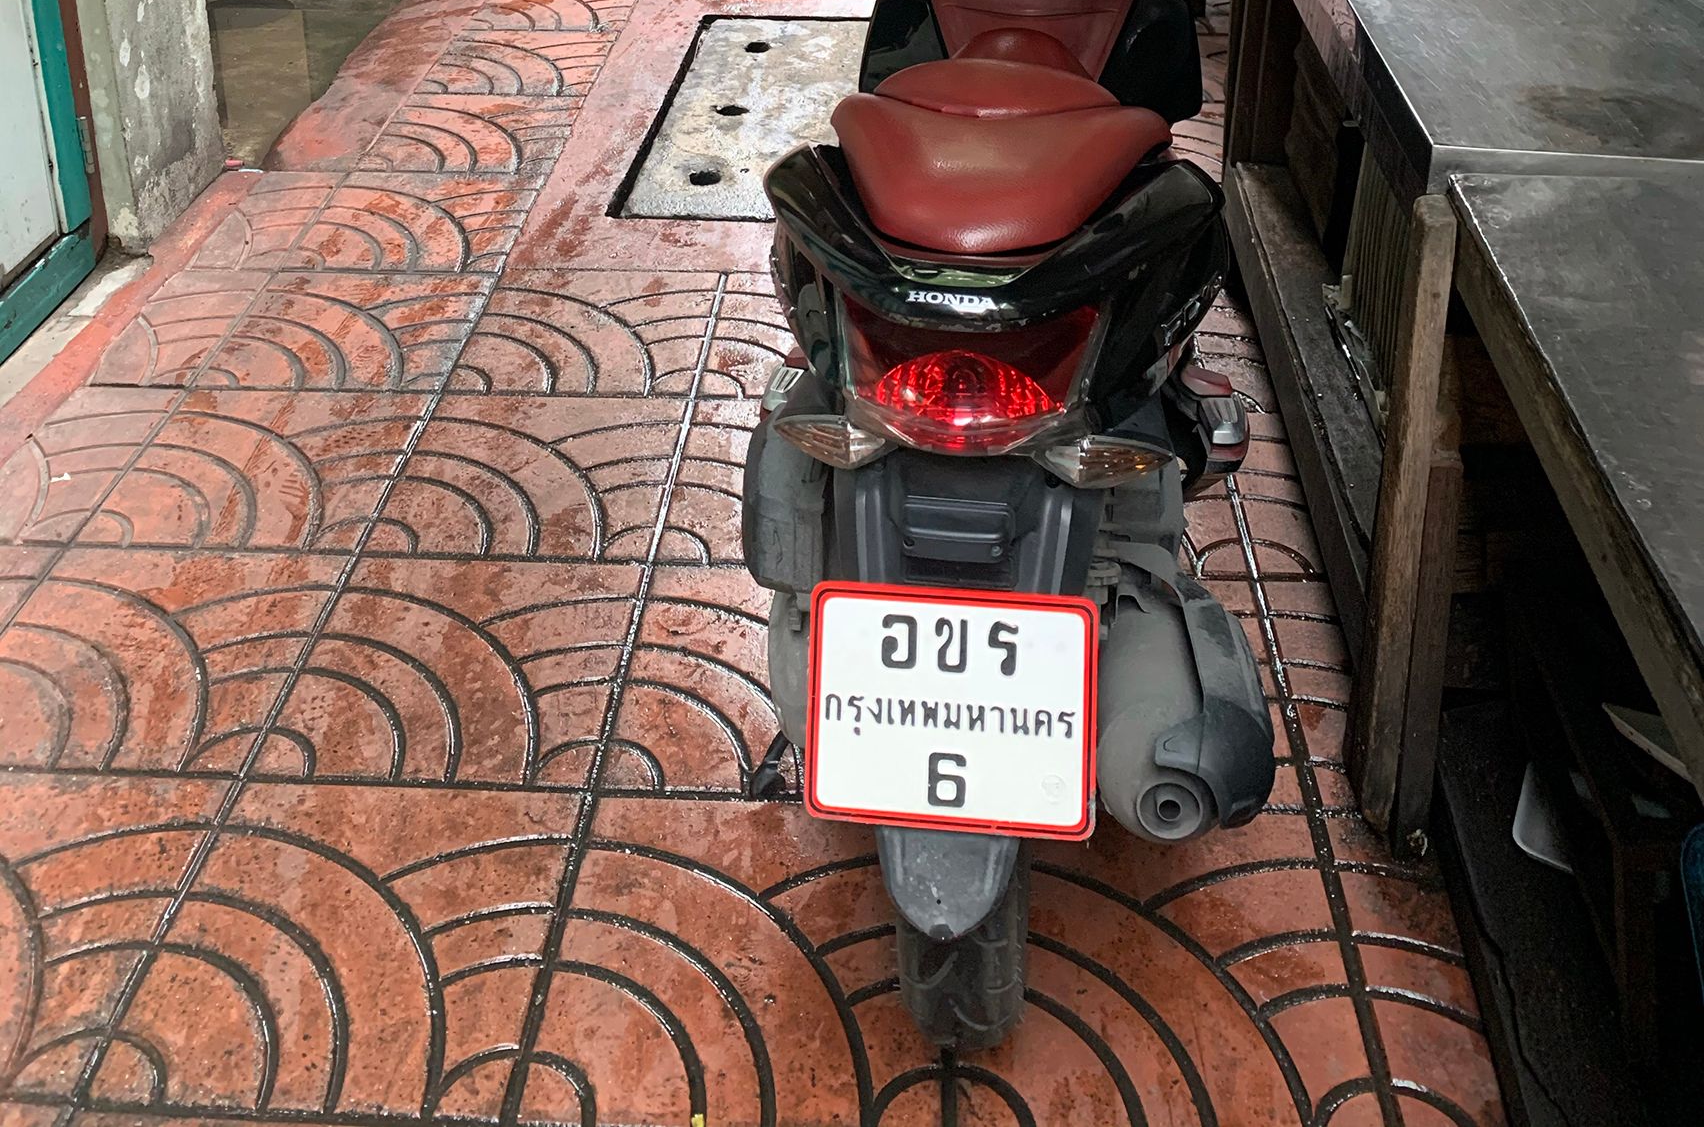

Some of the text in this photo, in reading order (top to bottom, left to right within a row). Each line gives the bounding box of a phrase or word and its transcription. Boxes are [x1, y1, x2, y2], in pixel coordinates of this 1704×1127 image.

[905, 290, 998, 310] HONDA
[881, 613, 1019, 676] อขร
[825, 692, 1076, 739] กรุงเทพมหานคร
[927, 752, 967, 808] 6
